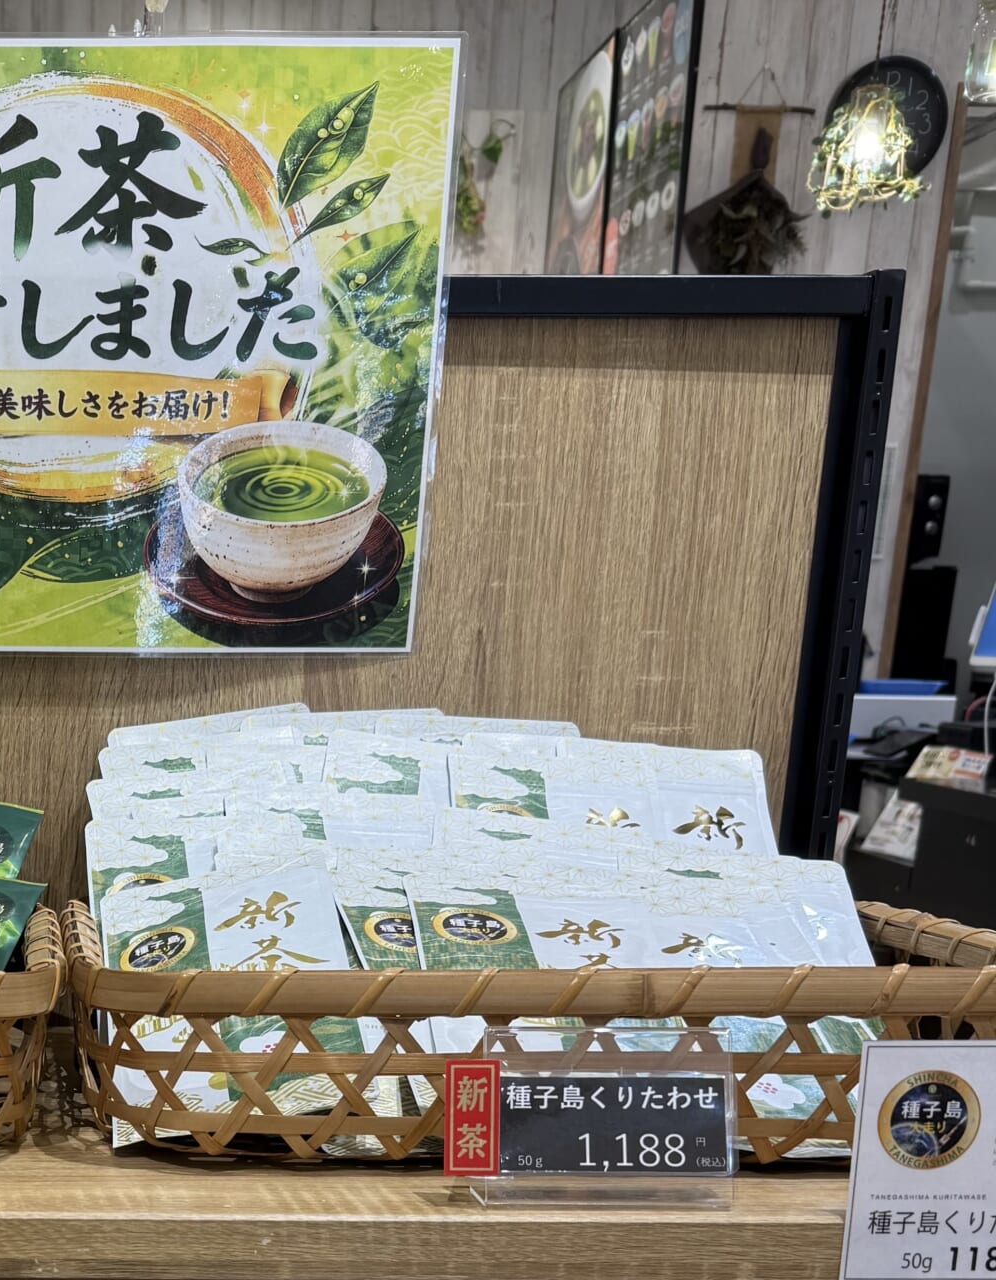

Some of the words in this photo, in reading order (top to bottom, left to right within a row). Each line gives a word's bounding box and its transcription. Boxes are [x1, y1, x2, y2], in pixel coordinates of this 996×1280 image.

[906, 1072, 959, 1089] SHINCHA
[506, 1084, 719, 1111] 種子島くりたわせ
[456, 1075, 488, 1160] 新茶
[901, 1101, 963, 1120] 種子島
[578, 1132, 687, 1173] 1,188
[695, 1136, 706, 1148] 円
[696, 1156, 726, 1168] (税込)
[888, 1145, 965, 1170] TANEGASHIMA
[901, 1252, 933, 1274] 50g
